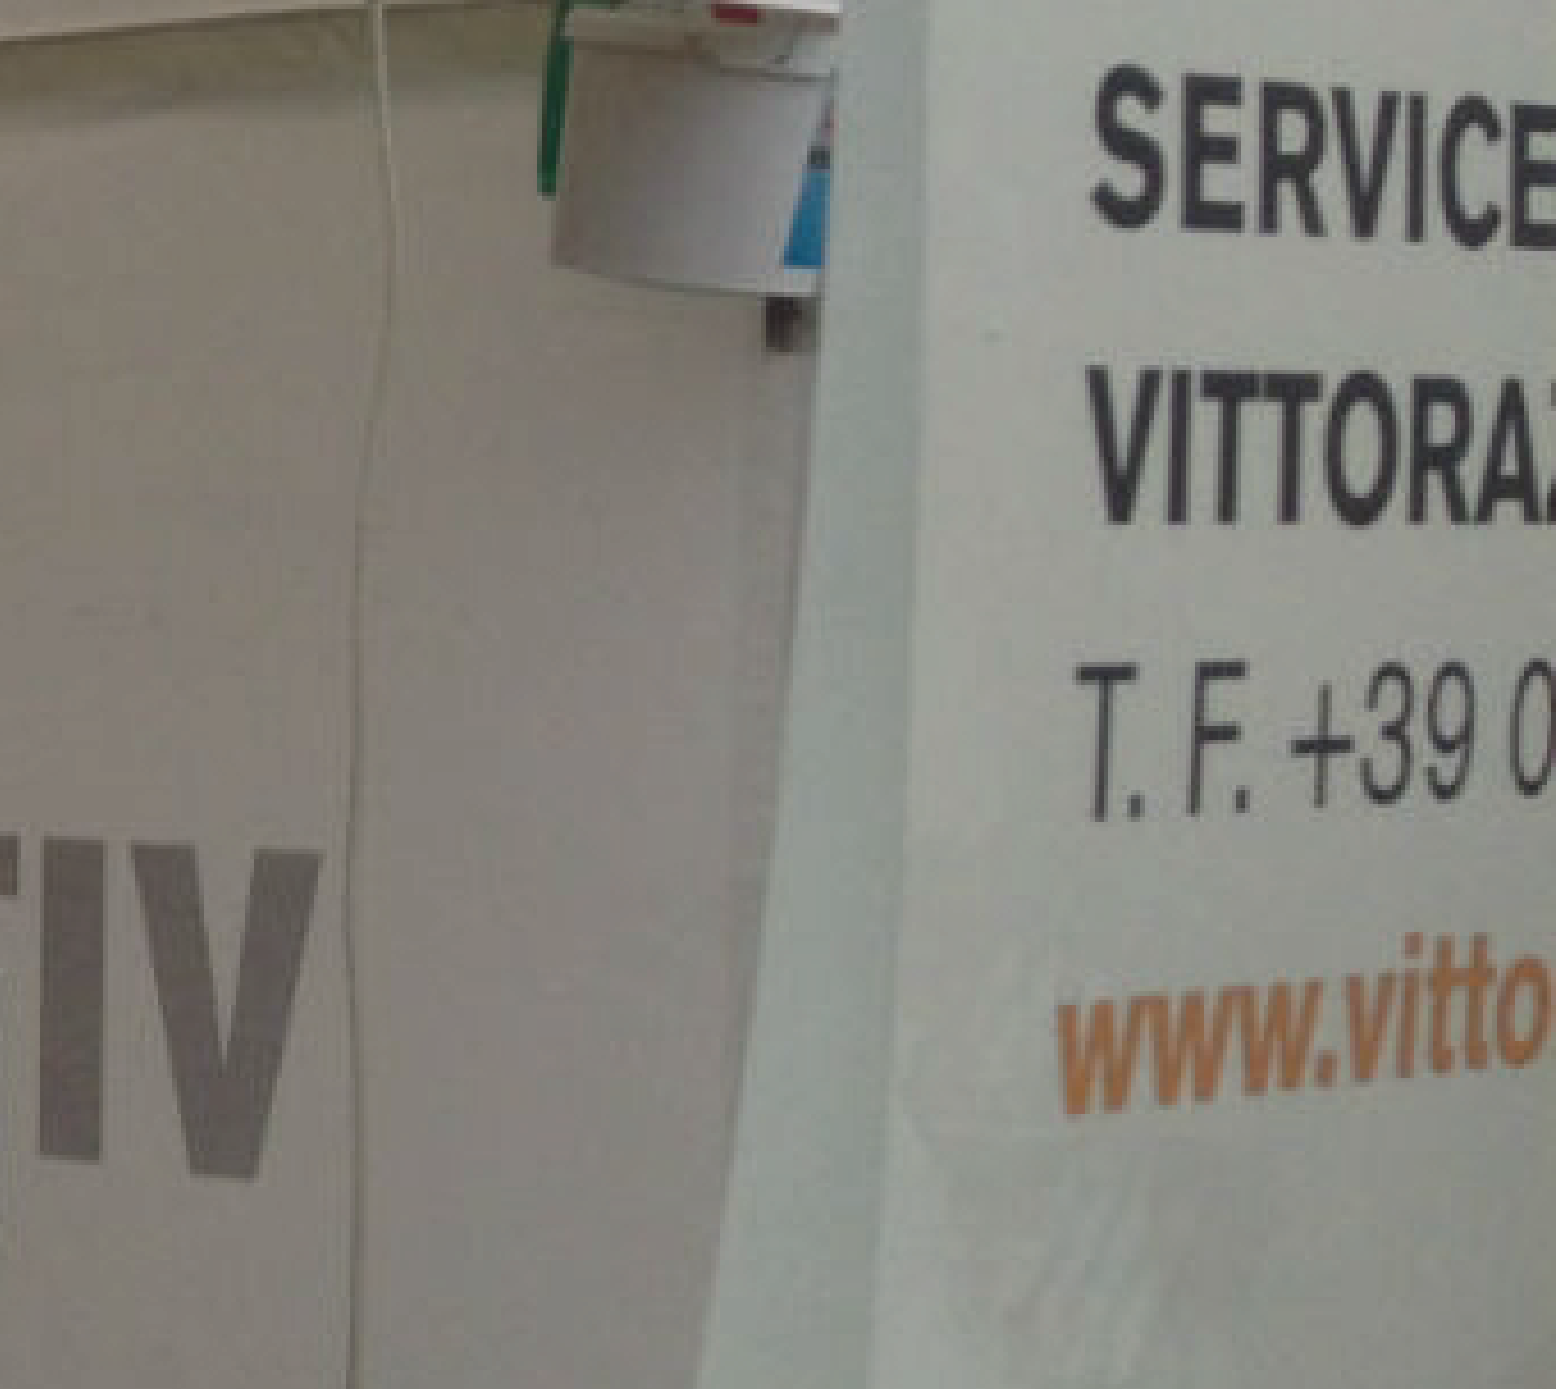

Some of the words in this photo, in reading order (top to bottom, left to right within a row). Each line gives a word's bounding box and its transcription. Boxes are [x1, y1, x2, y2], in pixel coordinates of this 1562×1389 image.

[1091, 63, 1556, 252] SERVICE
[1085, 364, 1556, 527] VITTORA
[1291, 658, 1476, 810] +39
[1056, 930, 1556, 1119] www.vitto
